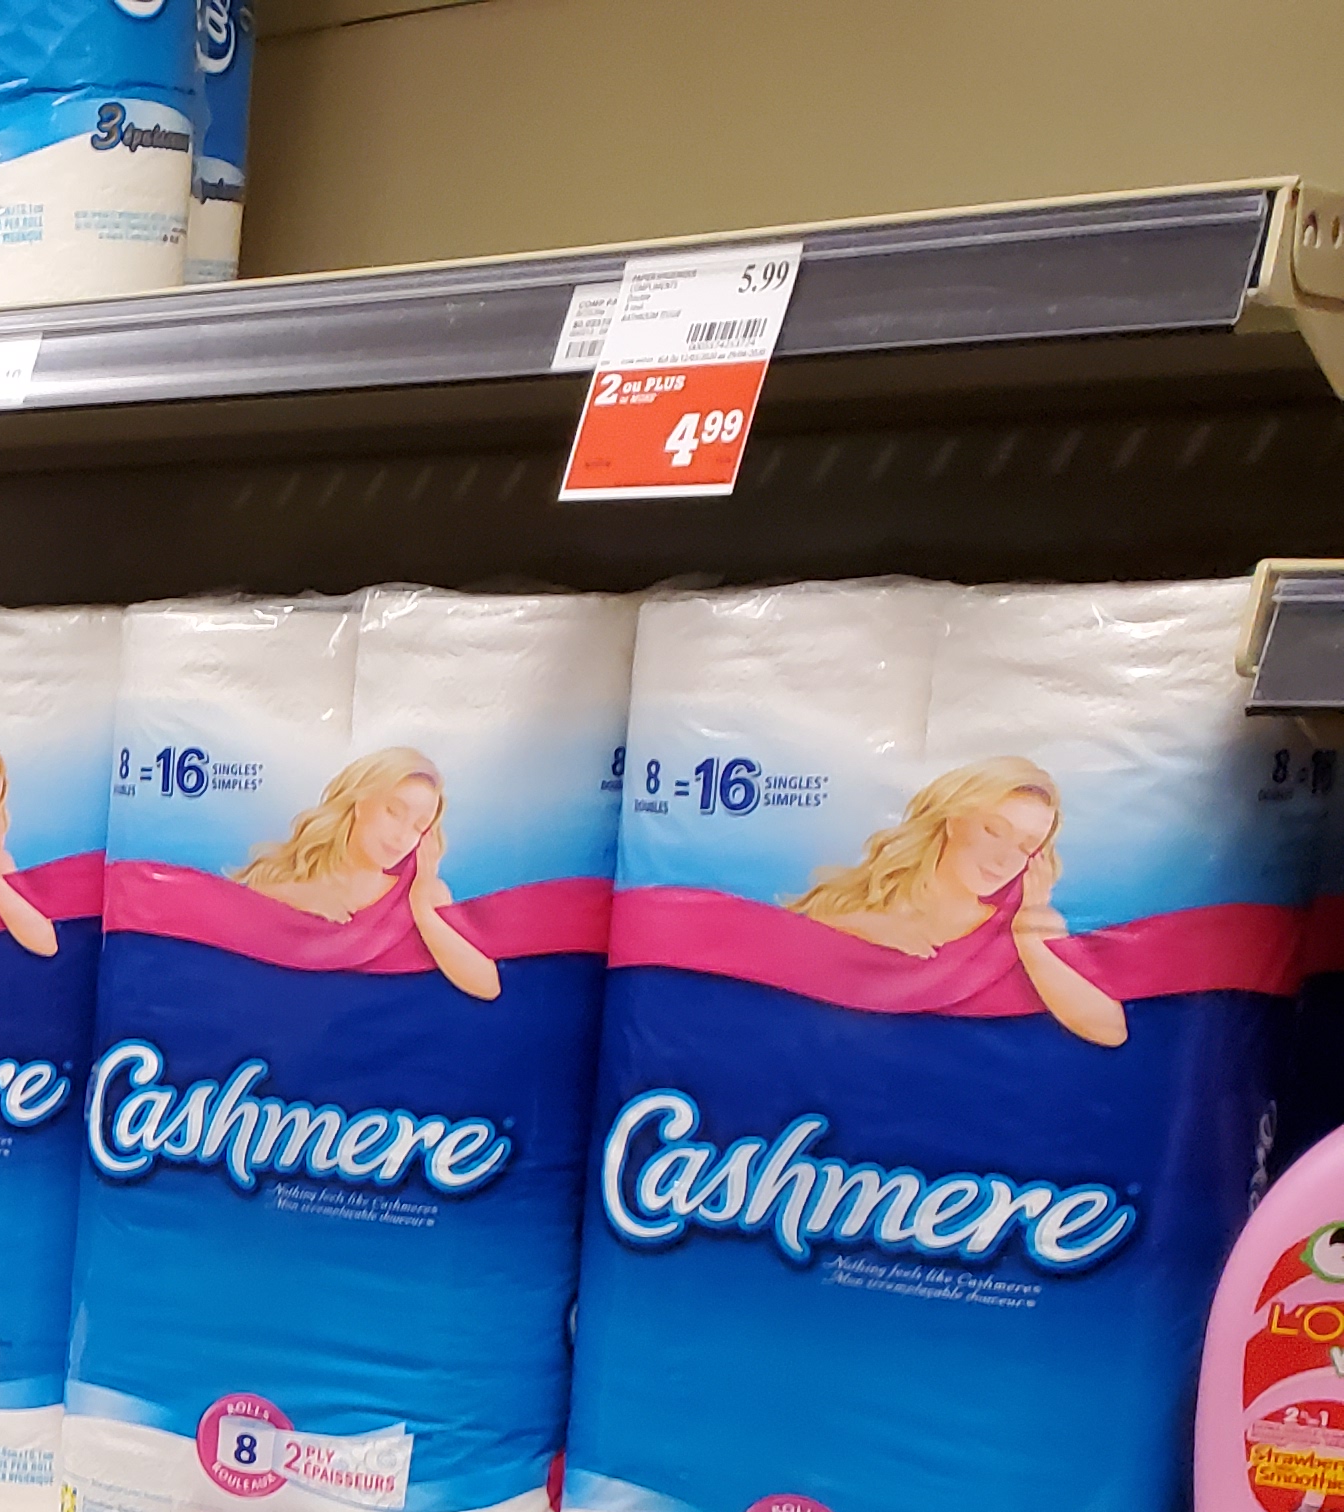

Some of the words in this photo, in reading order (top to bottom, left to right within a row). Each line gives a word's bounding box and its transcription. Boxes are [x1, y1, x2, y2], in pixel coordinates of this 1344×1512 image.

[91, 102, 125, 150] 3
[737, 260, 790, 294] 5.99
[593, 372, 623, 407] 2
[622, 379, 642, 394] ou
[643, 374, 686, 393] PLUS
[119, 747, 130, 782] 8
[646, 758, 662, 795] 8
[89, 1042, 508, 1188] Cashmere
[604, 1093, 1135, 1264] Cashmere
[234, 1432, 258, 1465] 8
[284, 1441, 302, 1472] 2
[305, 1447, 336, 1465] PLY
[302, 1462, 395, 1494] ÉPAISSEURS
